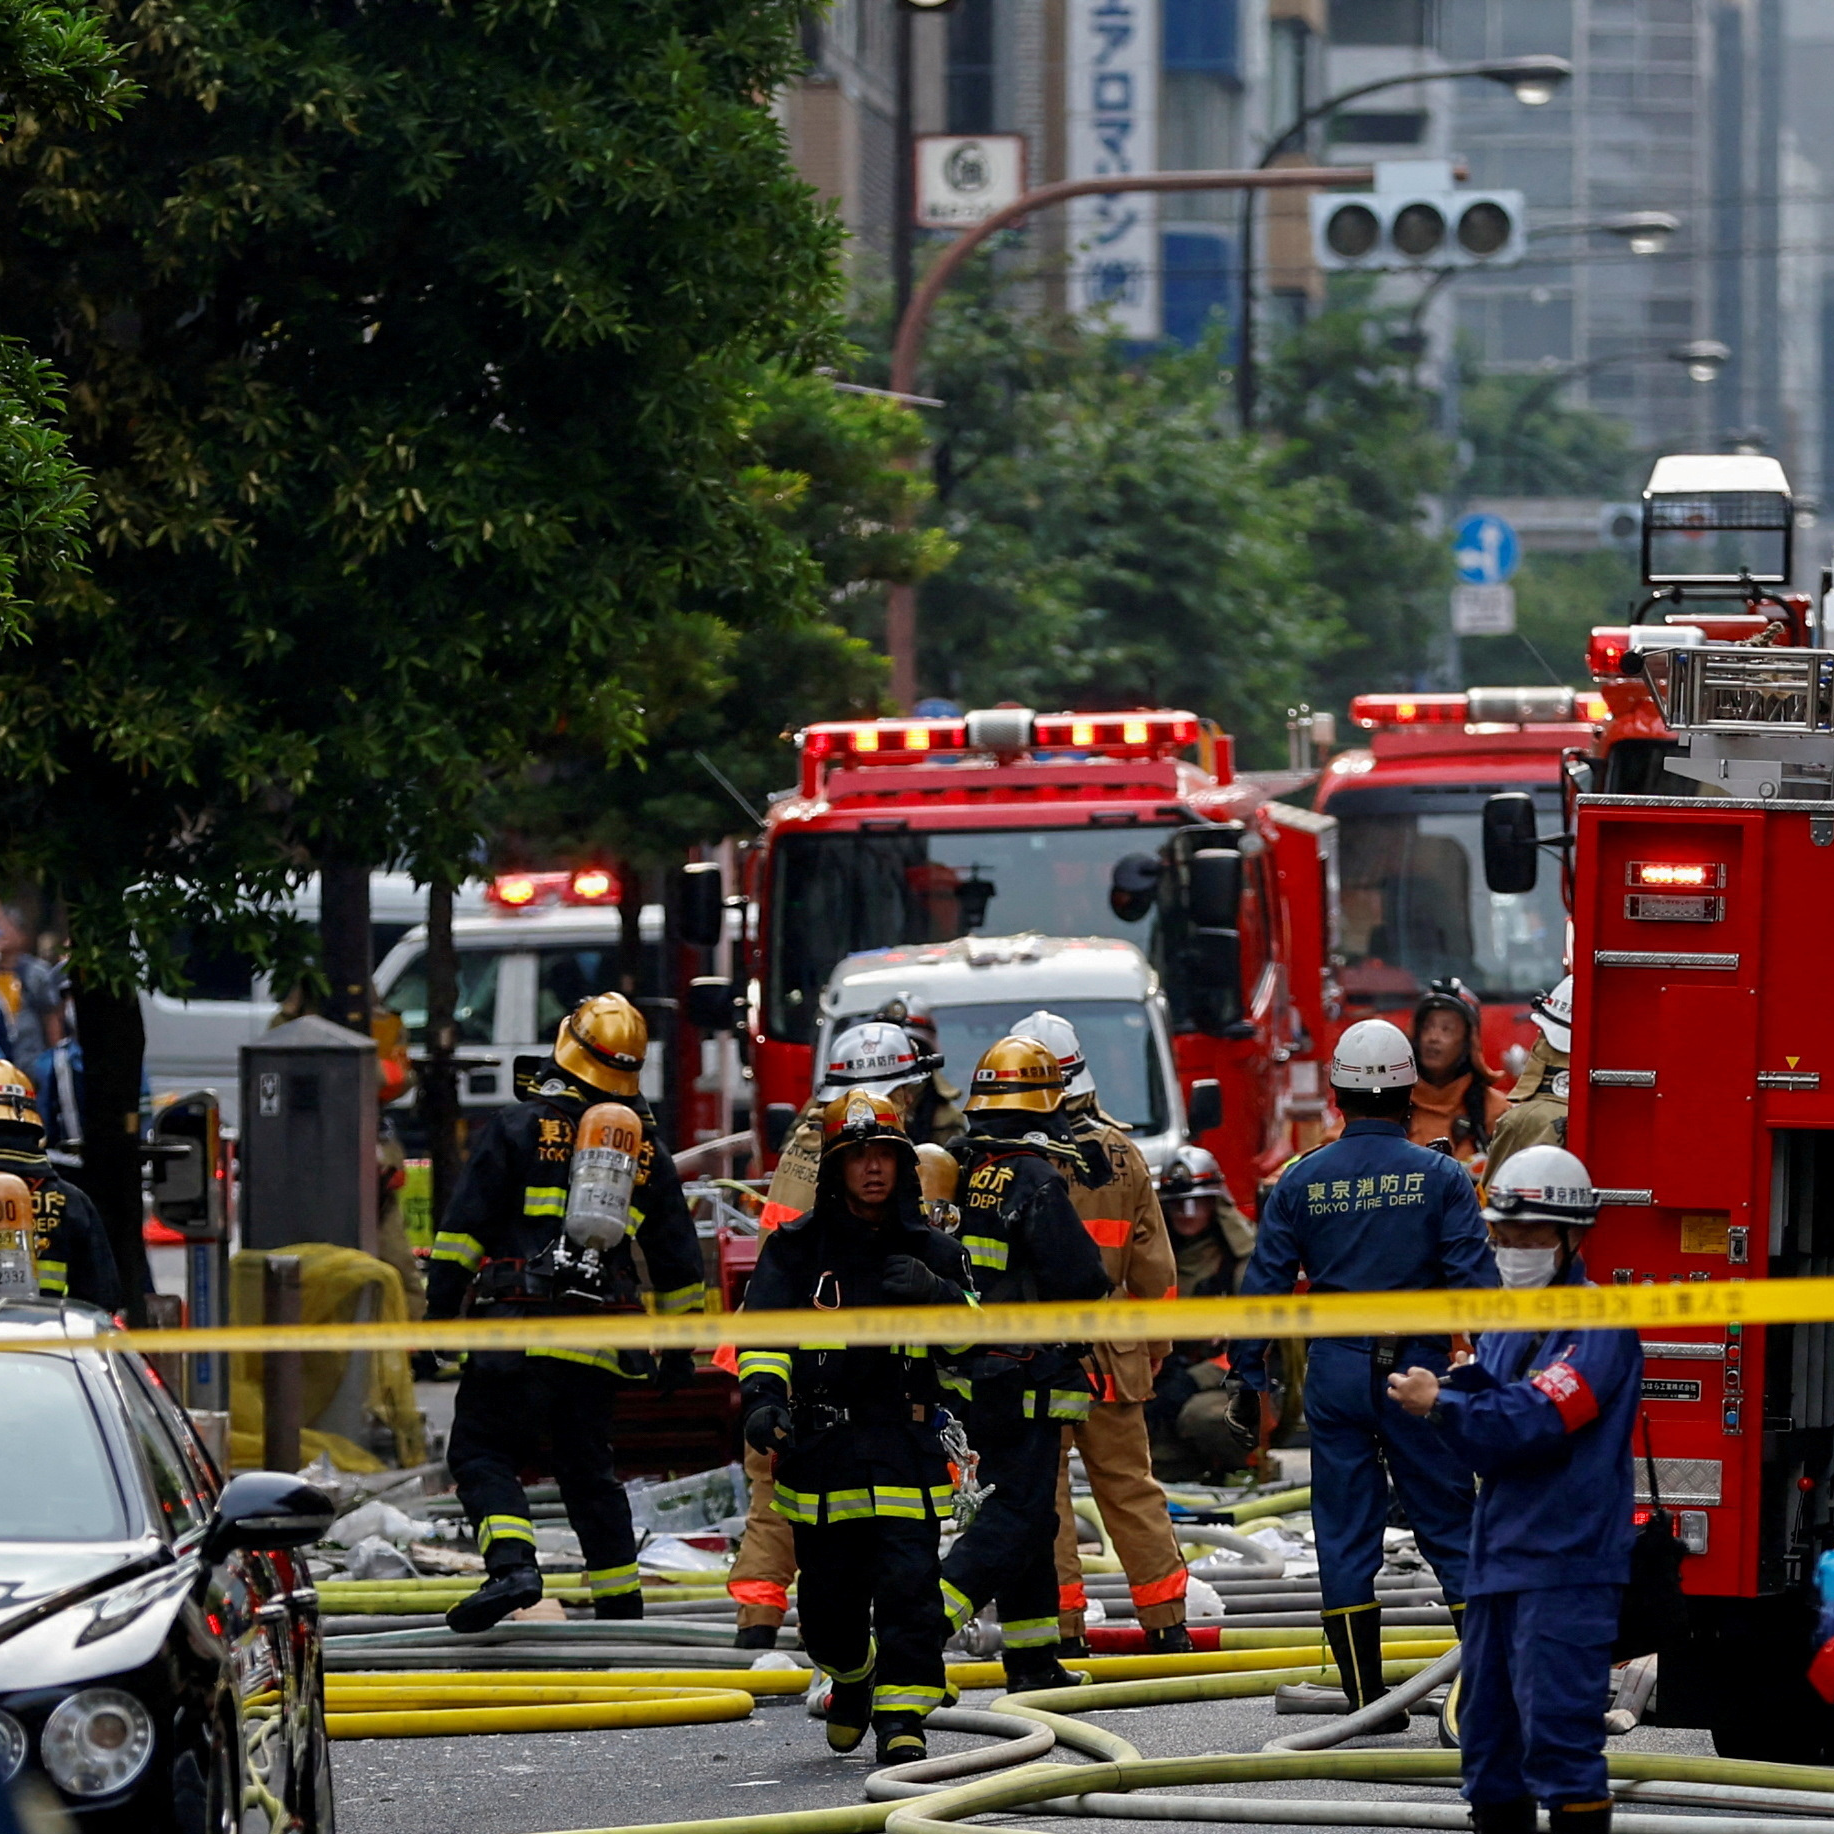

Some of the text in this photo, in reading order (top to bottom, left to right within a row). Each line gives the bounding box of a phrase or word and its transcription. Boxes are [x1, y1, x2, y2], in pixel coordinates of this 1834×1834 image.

[845, 1054, 897, 1071] 東京消防庁
[601, 1126, 634, 1152] 300
[1307, 1173, 1425, 1202] 東京消防庁
[1308, 1193, 1425, 1216] TOKYO FIRE DEPT.
